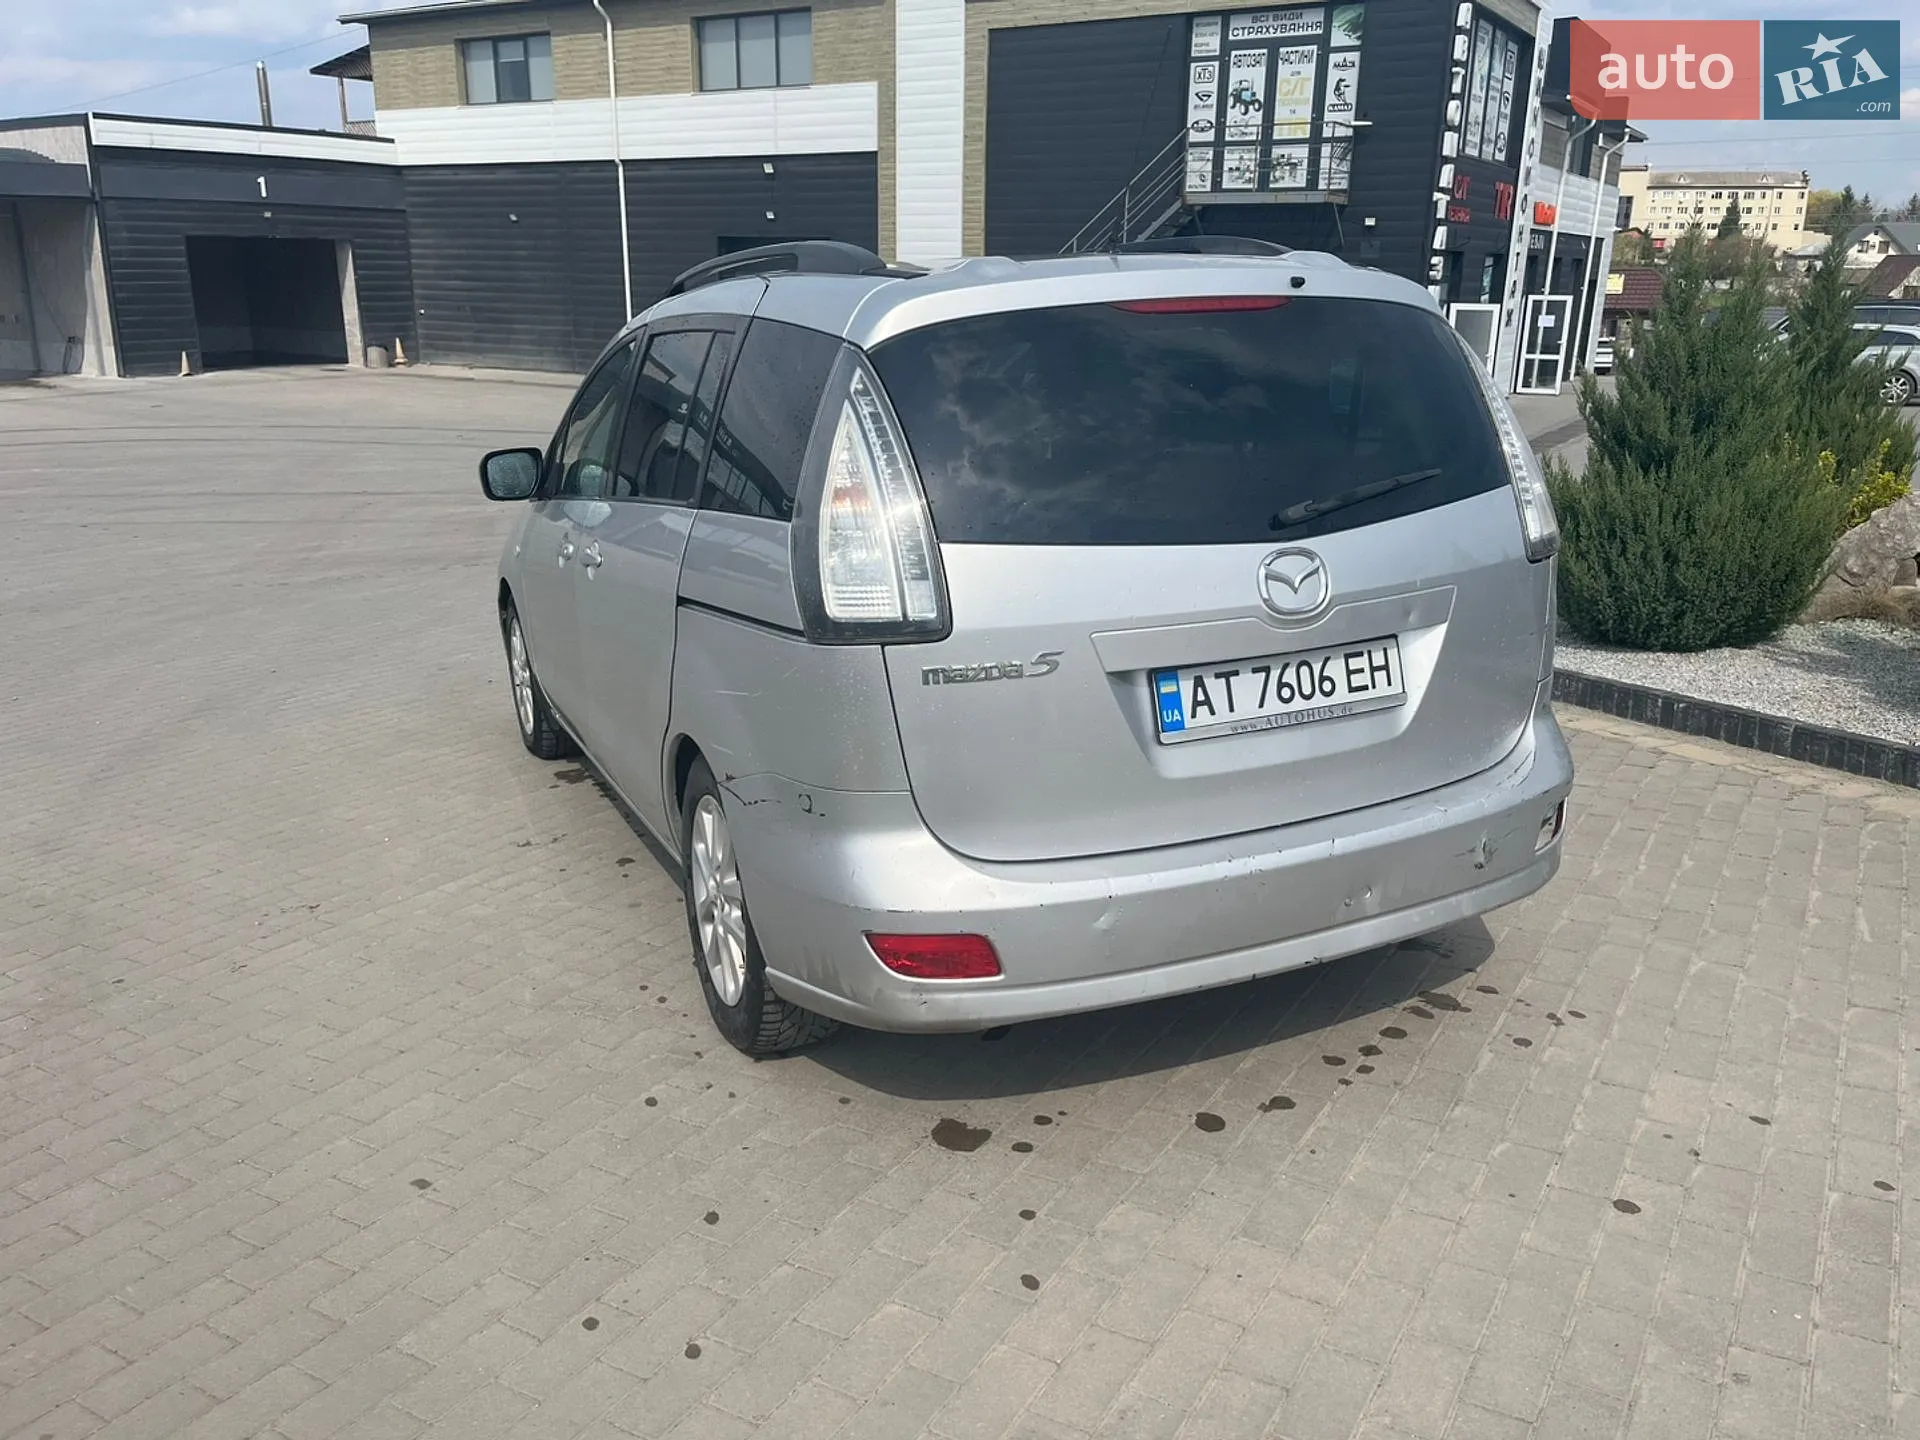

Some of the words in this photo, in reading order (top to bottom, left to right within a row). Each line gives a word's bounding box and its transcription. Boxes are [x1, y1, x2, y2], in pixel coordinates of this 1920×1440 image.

[1250, 14, 1269, 24] ВСІ
[1272, 11, 1303, 22] ВИДИ
[1231, 20, 1323, 37] СТРАХУВАННЯ
[257, 175, 268, 198] 1
[920, 660, 1024, 686] mazda
[1190, 669, 1240, 719] AT
[1251, 655, 1336, 709] 7606
[1343, 647, 1392, 694] EH
[1163, 709, 1182, 723] UA
